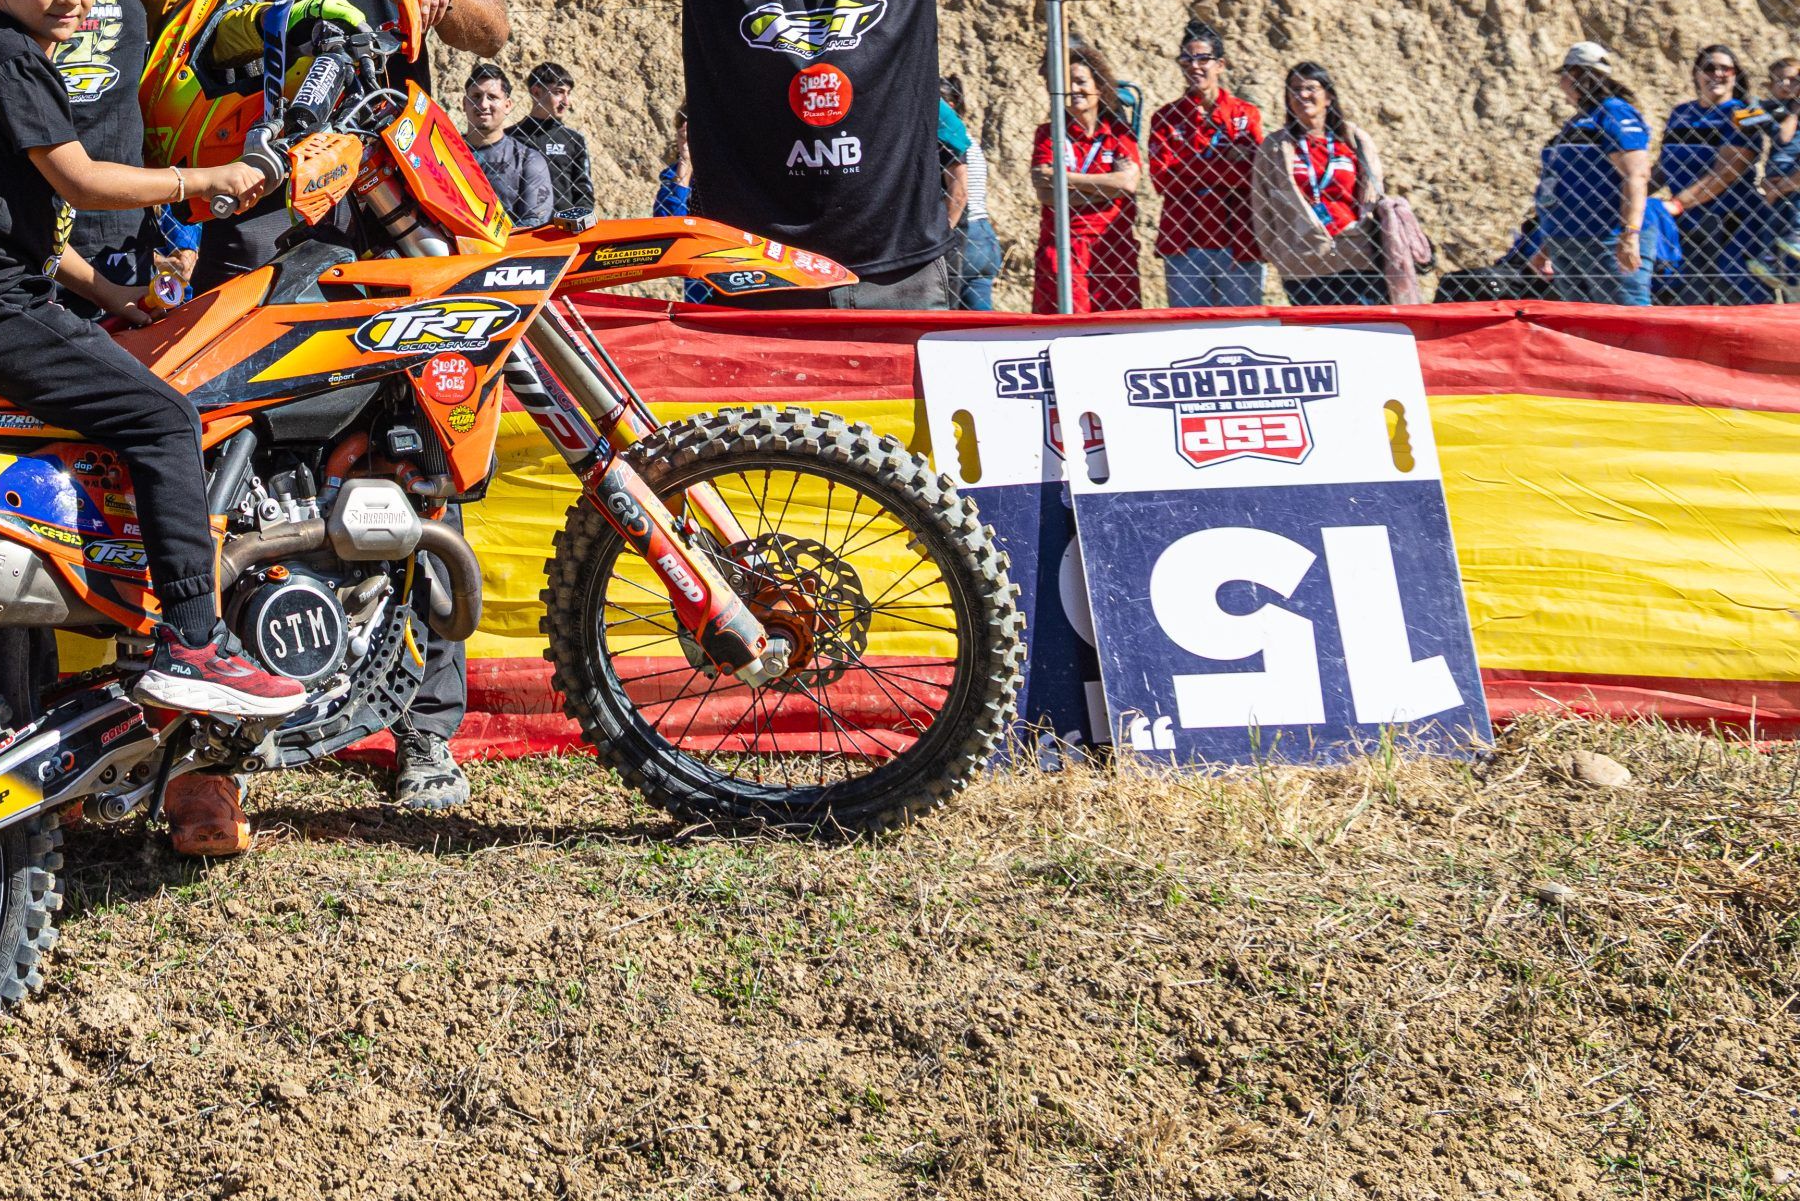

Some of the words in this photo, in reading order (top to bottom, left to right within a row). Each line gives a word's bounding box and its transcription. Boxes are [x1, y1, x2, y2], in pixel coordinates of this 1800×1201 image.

[429, 120, 489, 223] 1
[842, 166, 861, 174] ONE
[602, 258, 631, 266] SKYDIVE
[632, 256, 653, 264] SPAIN
[483, 265, 546, 287] KTM
[375, 309, 517, 349] TRT
[397, 342, 437, 351] racing
[438, 340, 486, 350] service
[1129, 365, 1334, 401] MOTOCROSS
[1179, 401, 1216, 413] ESPAÑA
[1217, 400, 1232, 410] DE
[1235, 399, 1296, 410] CAMPEONATO
[1182, 414, 1304, 452] ESP
[656, 552, 705, 603] REDD
[269, 606, 331, 659] STM
[170, 663, 192, 676] FILA
